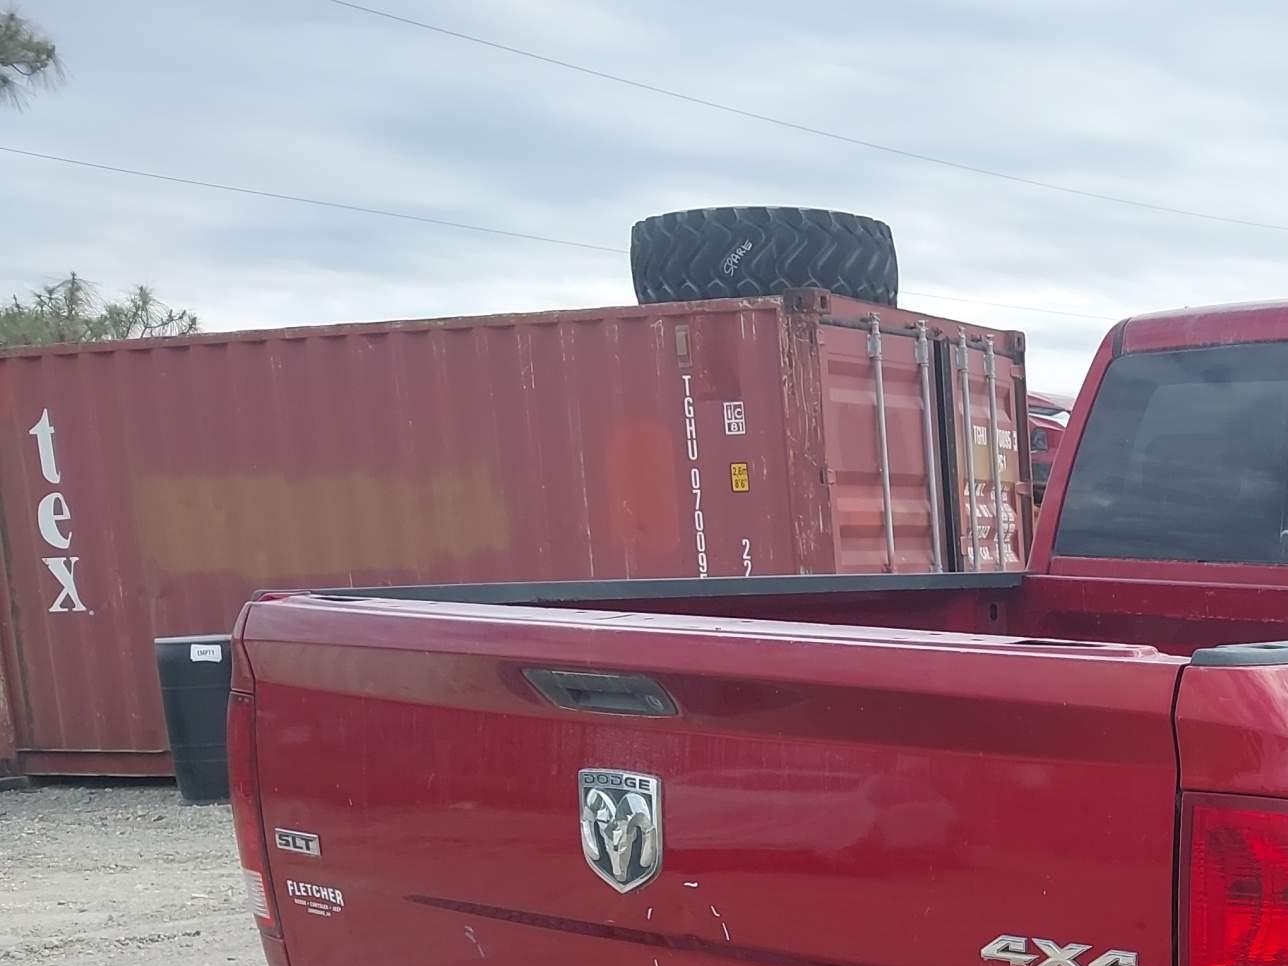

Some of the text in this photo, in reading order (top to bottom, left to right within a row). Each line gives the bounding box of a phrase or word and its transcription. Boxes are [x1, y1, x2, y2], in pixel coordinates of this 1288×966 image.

[723, 239, 753, 277] SPARE
[682, 375, 708, 580] TGHU 07009
[583, 773, 651, 792] DODGE
[278, 834, 313, 851] SLT
[286, 879, 345, 907] FLETCHER
